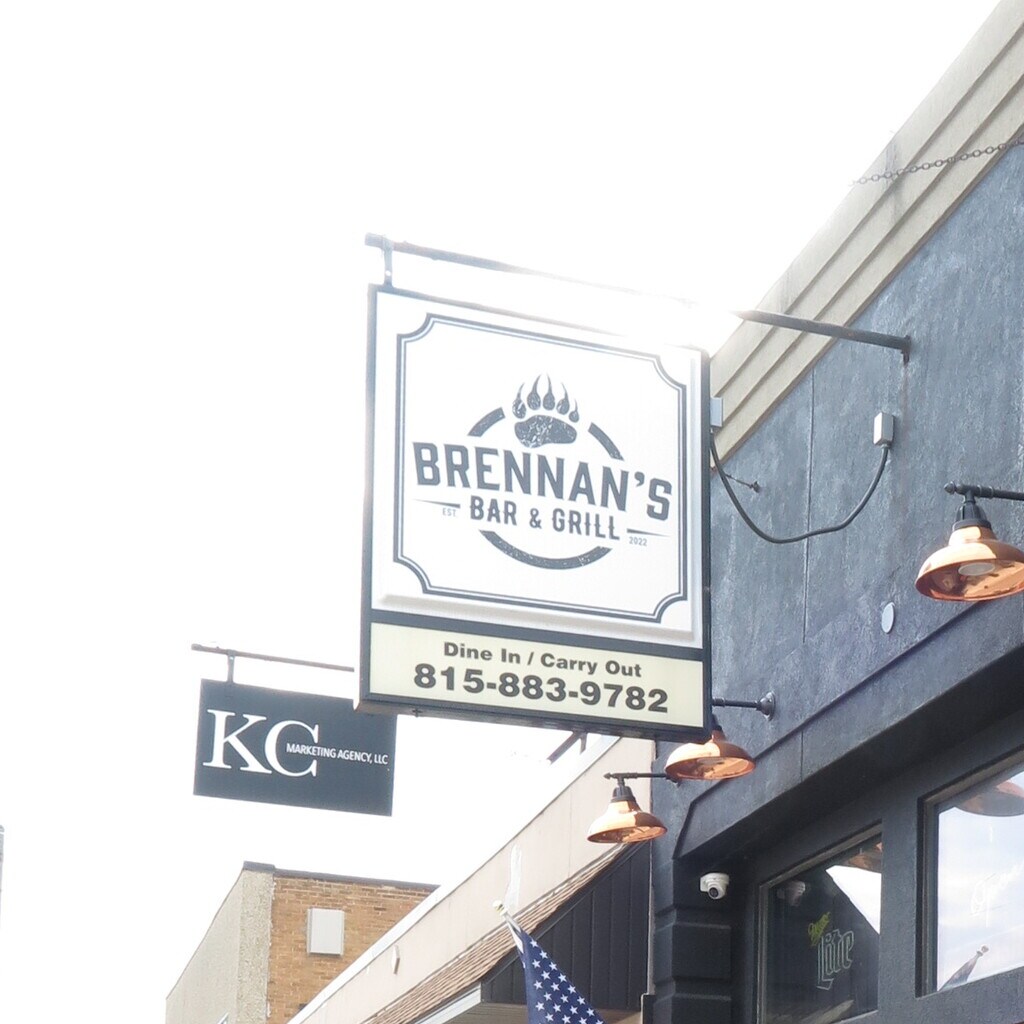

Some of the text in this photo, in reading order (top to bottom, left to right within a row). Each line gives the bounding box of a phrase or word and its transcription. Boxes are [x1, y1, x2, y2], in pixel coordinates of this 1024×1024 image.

[412, 441, 674, 521] BRENNAN'S
[469, 495, 621, 541] BAR & GRILL
[628, 536, 648, 547] 2022
[443, 642, 642, 678] Dine In / Carry Out
[413, 663, 669, 714] 815-883-9782
[202, 709, 320, 777] KC
[286, 743, 389, 765] MARKETING AGENCY, LLC
[816, 928, 855, 991] Lite
